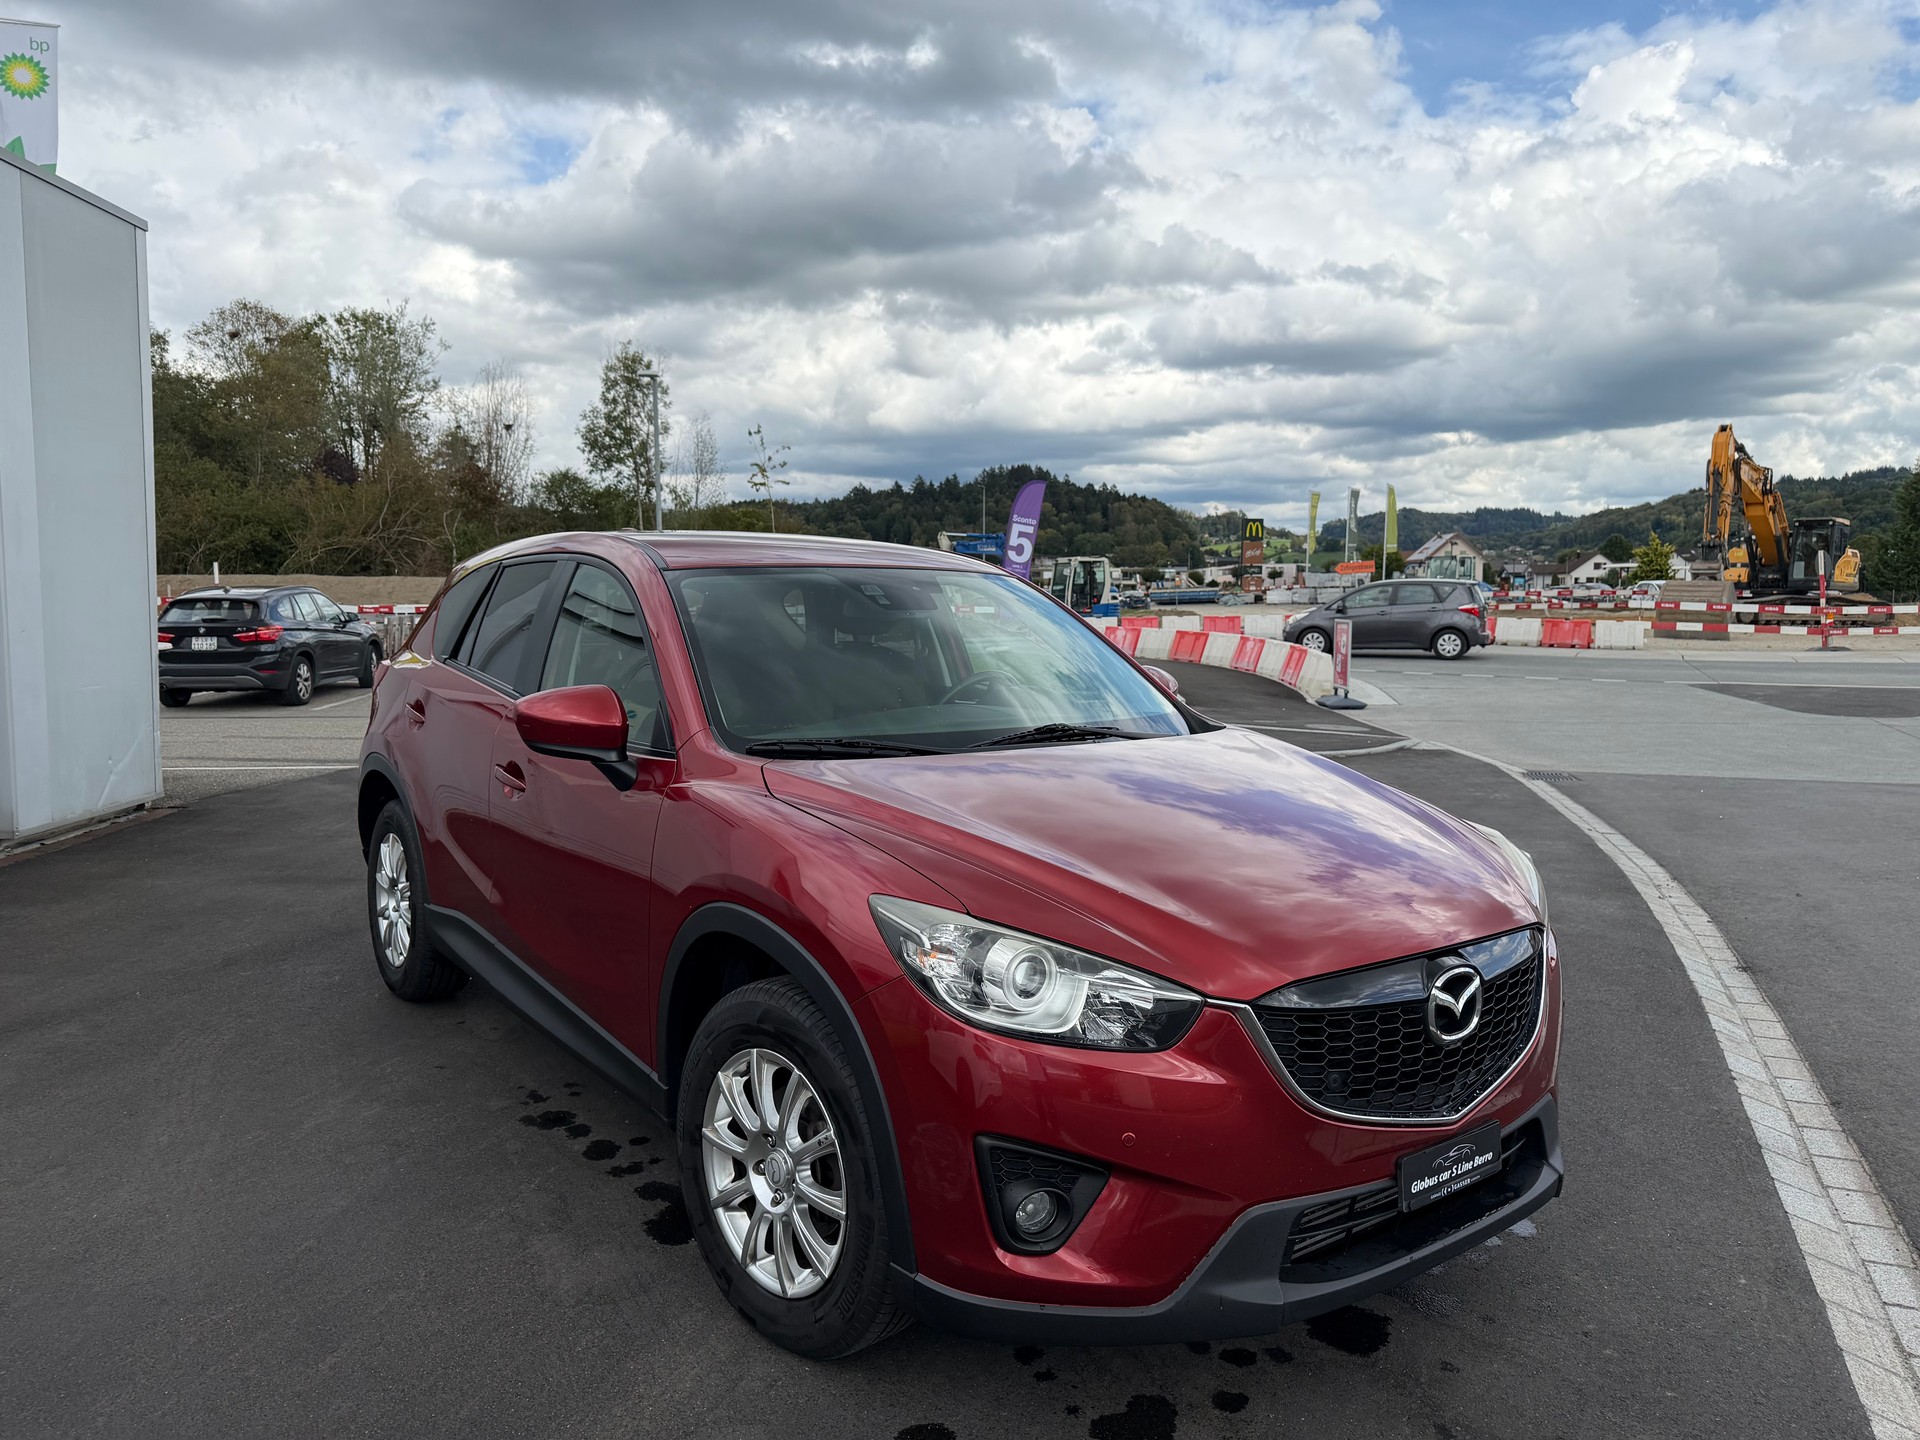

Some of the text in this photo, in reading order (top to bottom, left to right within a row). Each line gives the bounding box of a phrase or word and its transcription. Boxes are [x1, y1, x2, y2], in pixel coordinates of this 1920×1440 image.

[30, 37, 50, 54] bp
[1012, 514, 1037, 525] Sconto
[1007, 523, 1035, 563] 5
[1411, 1152, 1493, 1194] Globus car S Line Berro
[836, 1213, 875, 1321] BRIDGESTONE
